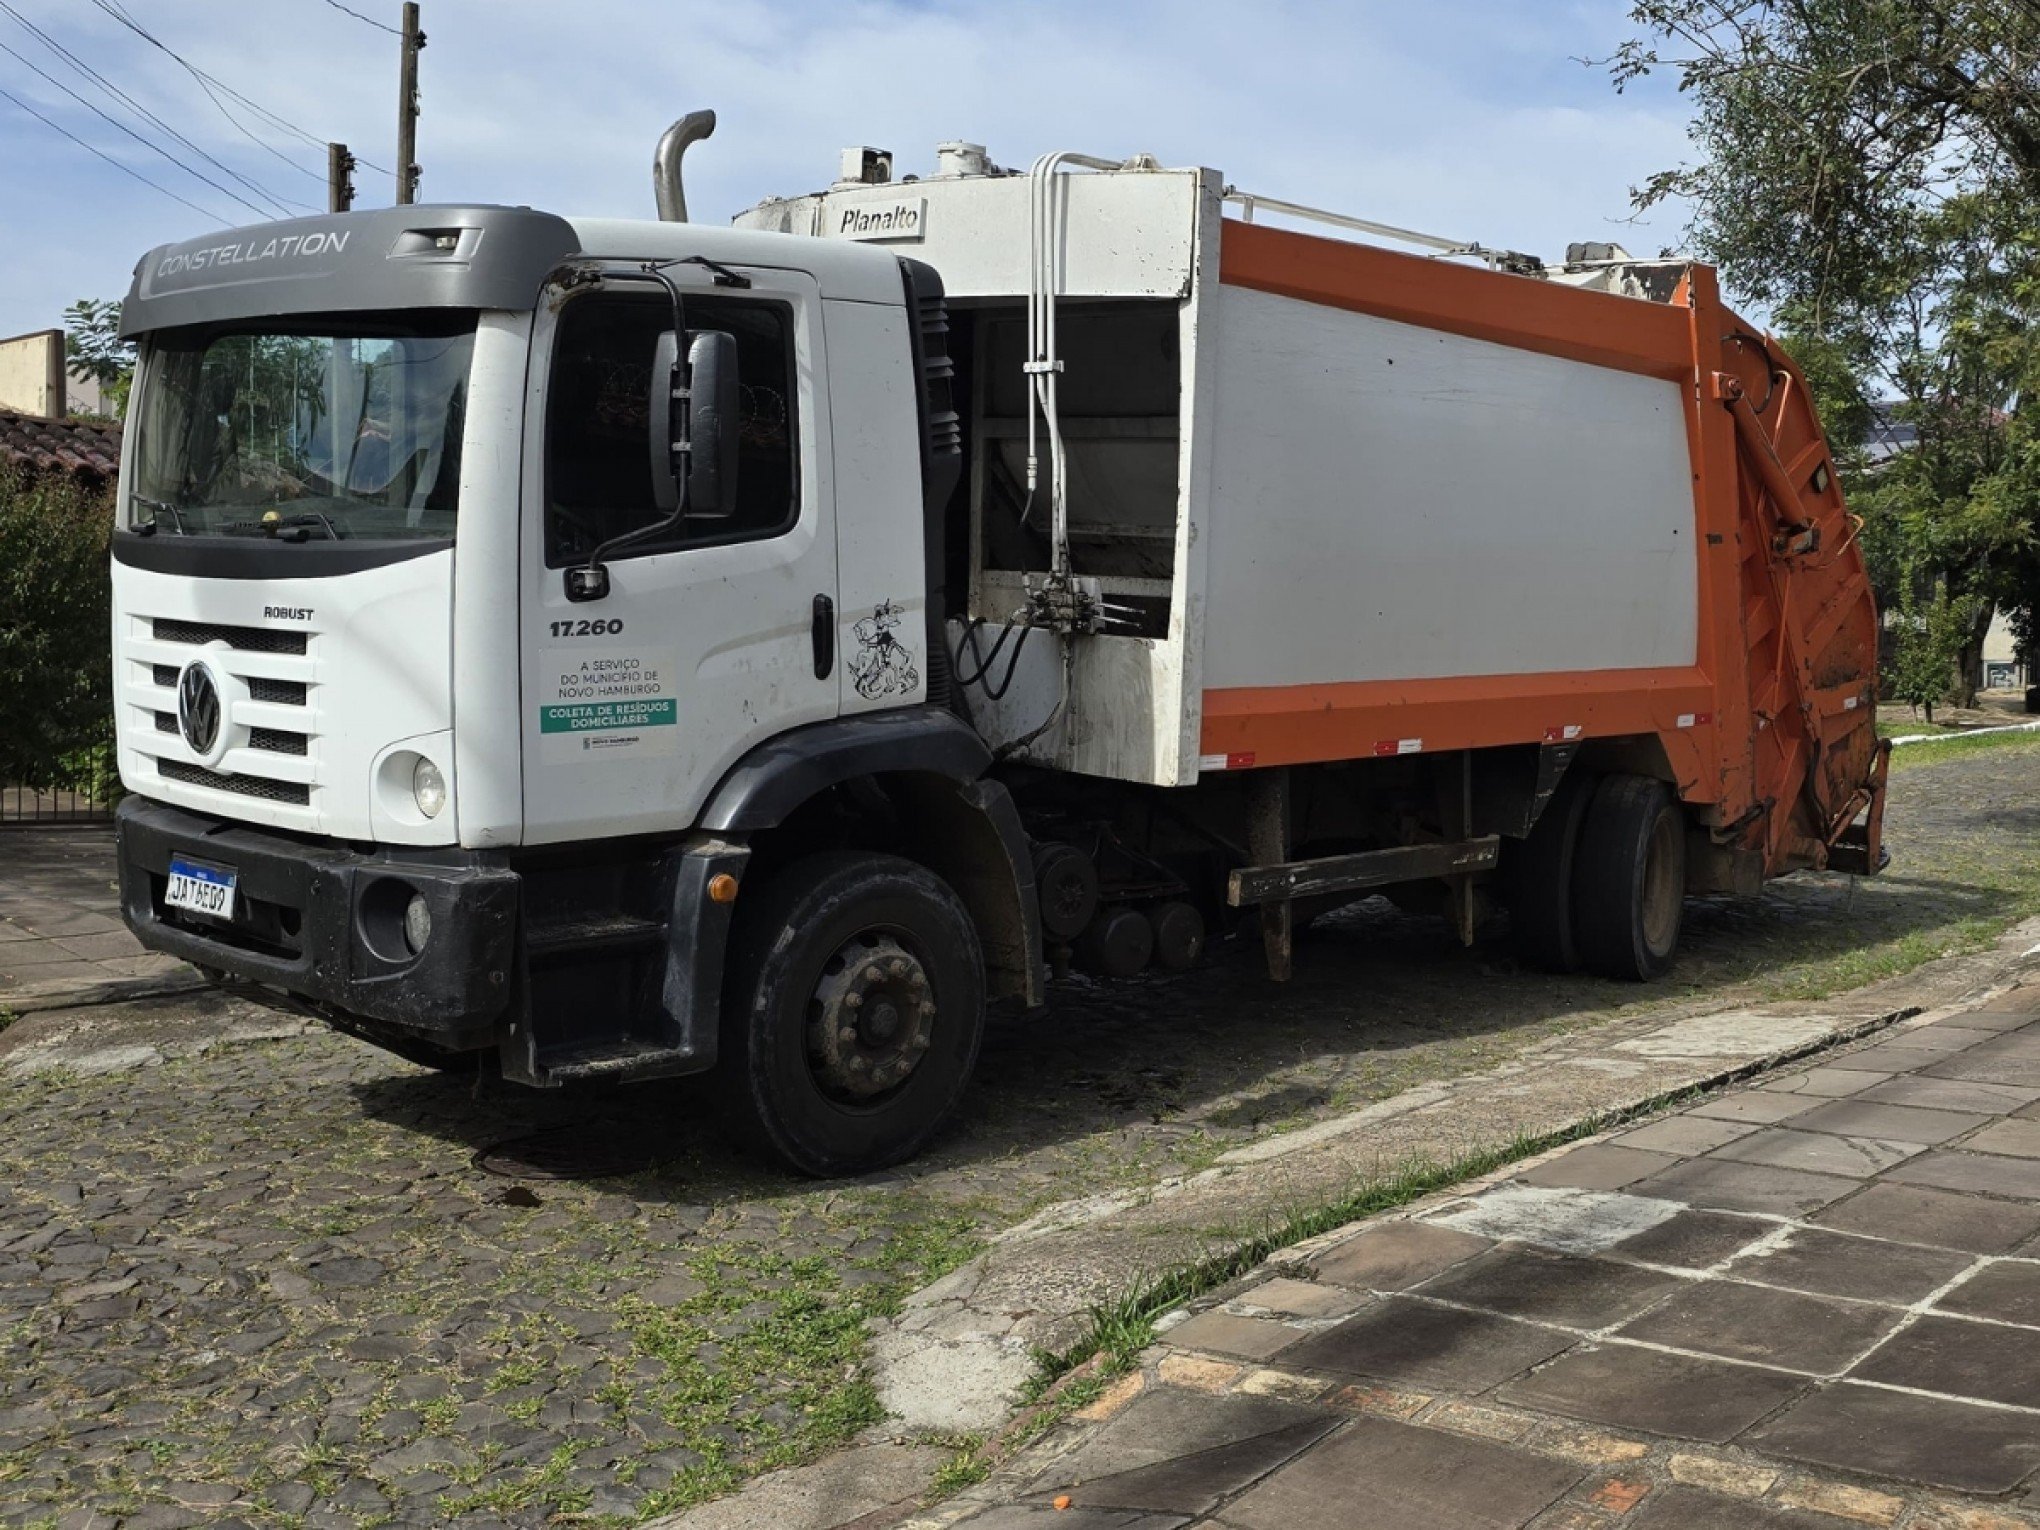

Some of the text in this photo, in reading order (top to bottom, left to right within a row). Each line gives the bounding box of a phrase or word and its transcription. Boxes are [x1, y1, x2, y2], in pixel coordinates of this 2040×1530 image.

[840, 205, 918, 233] Planalto
[157, 231, 351, 277] CONSTELLATION
[264, 606, 315, 621] ROBUST
[550, 618, 624, 637] 17.260
[581, 658, 640, 671] A SERVIÇO
[560, 674, 579, 686] DO
[643, 671, 658, 681] DE
[558, 682, 661, 698] NOVO HAMBURGO
[548, 706, 594, 719] COLETA
[597, 705, 613, 716] DE
[571, 714, 649, 729] DOMICILIARES
